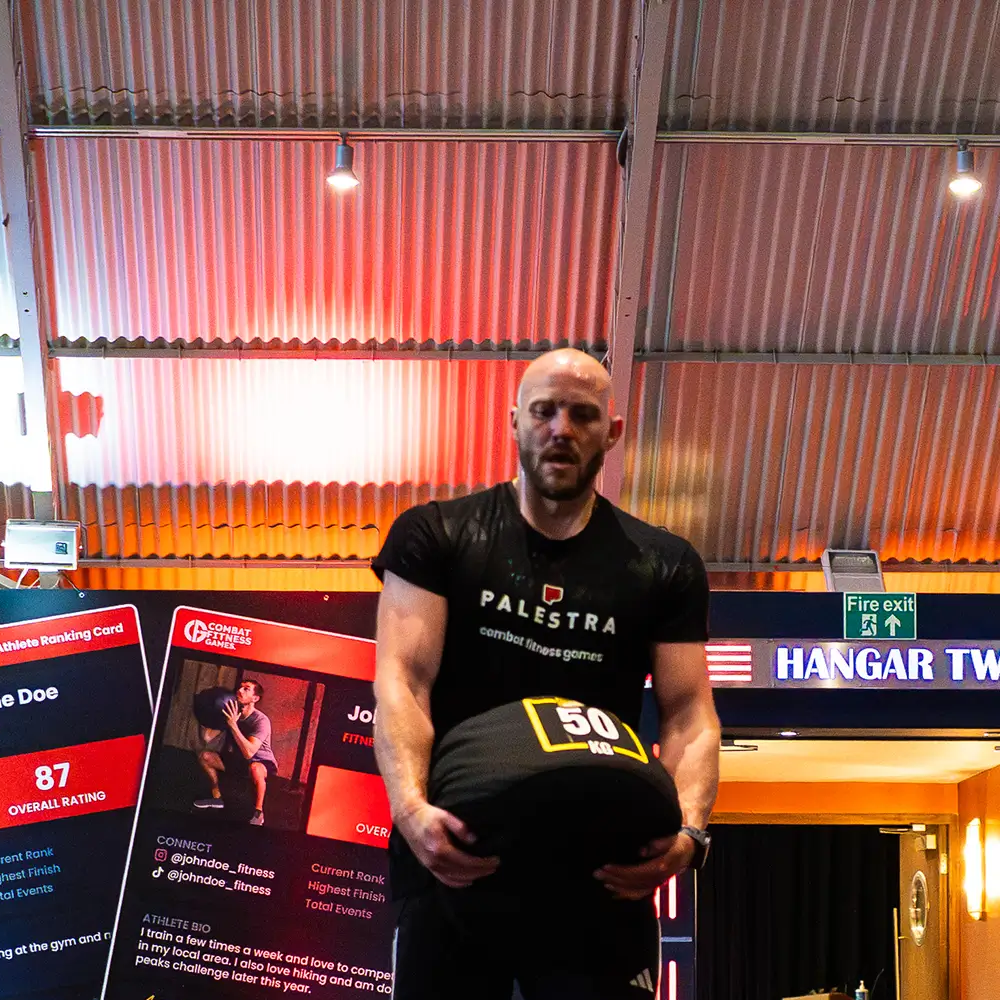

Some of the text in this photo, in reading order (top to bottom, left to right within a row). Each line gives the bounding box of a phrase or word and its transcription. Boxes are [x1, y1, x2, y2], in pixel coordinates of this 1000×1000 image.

[480, 589, 616, 634] PALESTRA
[847, 596, 914, 612] Fire exit
[40, 630, 91, 646] Ranking
[93, 622, 124, 636] Card
[207, 631, 252, 645] FITNESS
[208, 623, 251, 636] COMBAT
[479, 626, 603, 661] combat fitness games
[775, 646, 935, 681] HANGAR
[18, 686, 59, 705] Doe
[556, 707, 619, 740] 50
[343, 732, 374, 747] FITNE
[35, 762, 70, 791] 87
[8, 791, 106, 816] OVERALL RATING
[26, 847, 54, 859] Rank
[157, 836, 212, 853] CONNECT
[28, 864, 61, 877] Finish
[171, 853, 275, 879] @johndoe_fitness
[311, 863, 385, 885] Current Rank
[17, 885, 53, 897] Events
[167, 870, 271, 896] @johndoe_fitness
[308, 881, 385, 903] Highest Finish
[305, 899, 373, 919] Total Events
[143, 914, 211, 933] ATHLETE BIO
[15, 945, 28, 956] at
[29, 942, 48, 952] the
[50, 937, 76, 952] gym
[79, 932, 101, 944] and
[140, 927, 144, 936] I
[147, 928, 173, 941] train
[175, 935, 183, 943] a
[186, 935, 207, 947] few
[209, 940, 241, 954] times
[243, 947, 251, 955] a
[254, 949, 284, 961] week
[285, 954, 309, 966] and
[311, 957, 334, 970] love
[337, 963, 349, 973] to
[135, 955, 311, 994] peaks challenge later this year.
[138, 940, 148, 951] in
[151, 944, 170, 957] my
[172, 946, 200, 960] local
[203, 953, 231, 966] area.
[234, 958, 238, 966] I
[240, 960, 264, 971] also
[266, 963, 290, 976] love
[293, 968, 327, 985] hiking
[329, 975, 353, 987] and
[355, 979, 374, 991] am
